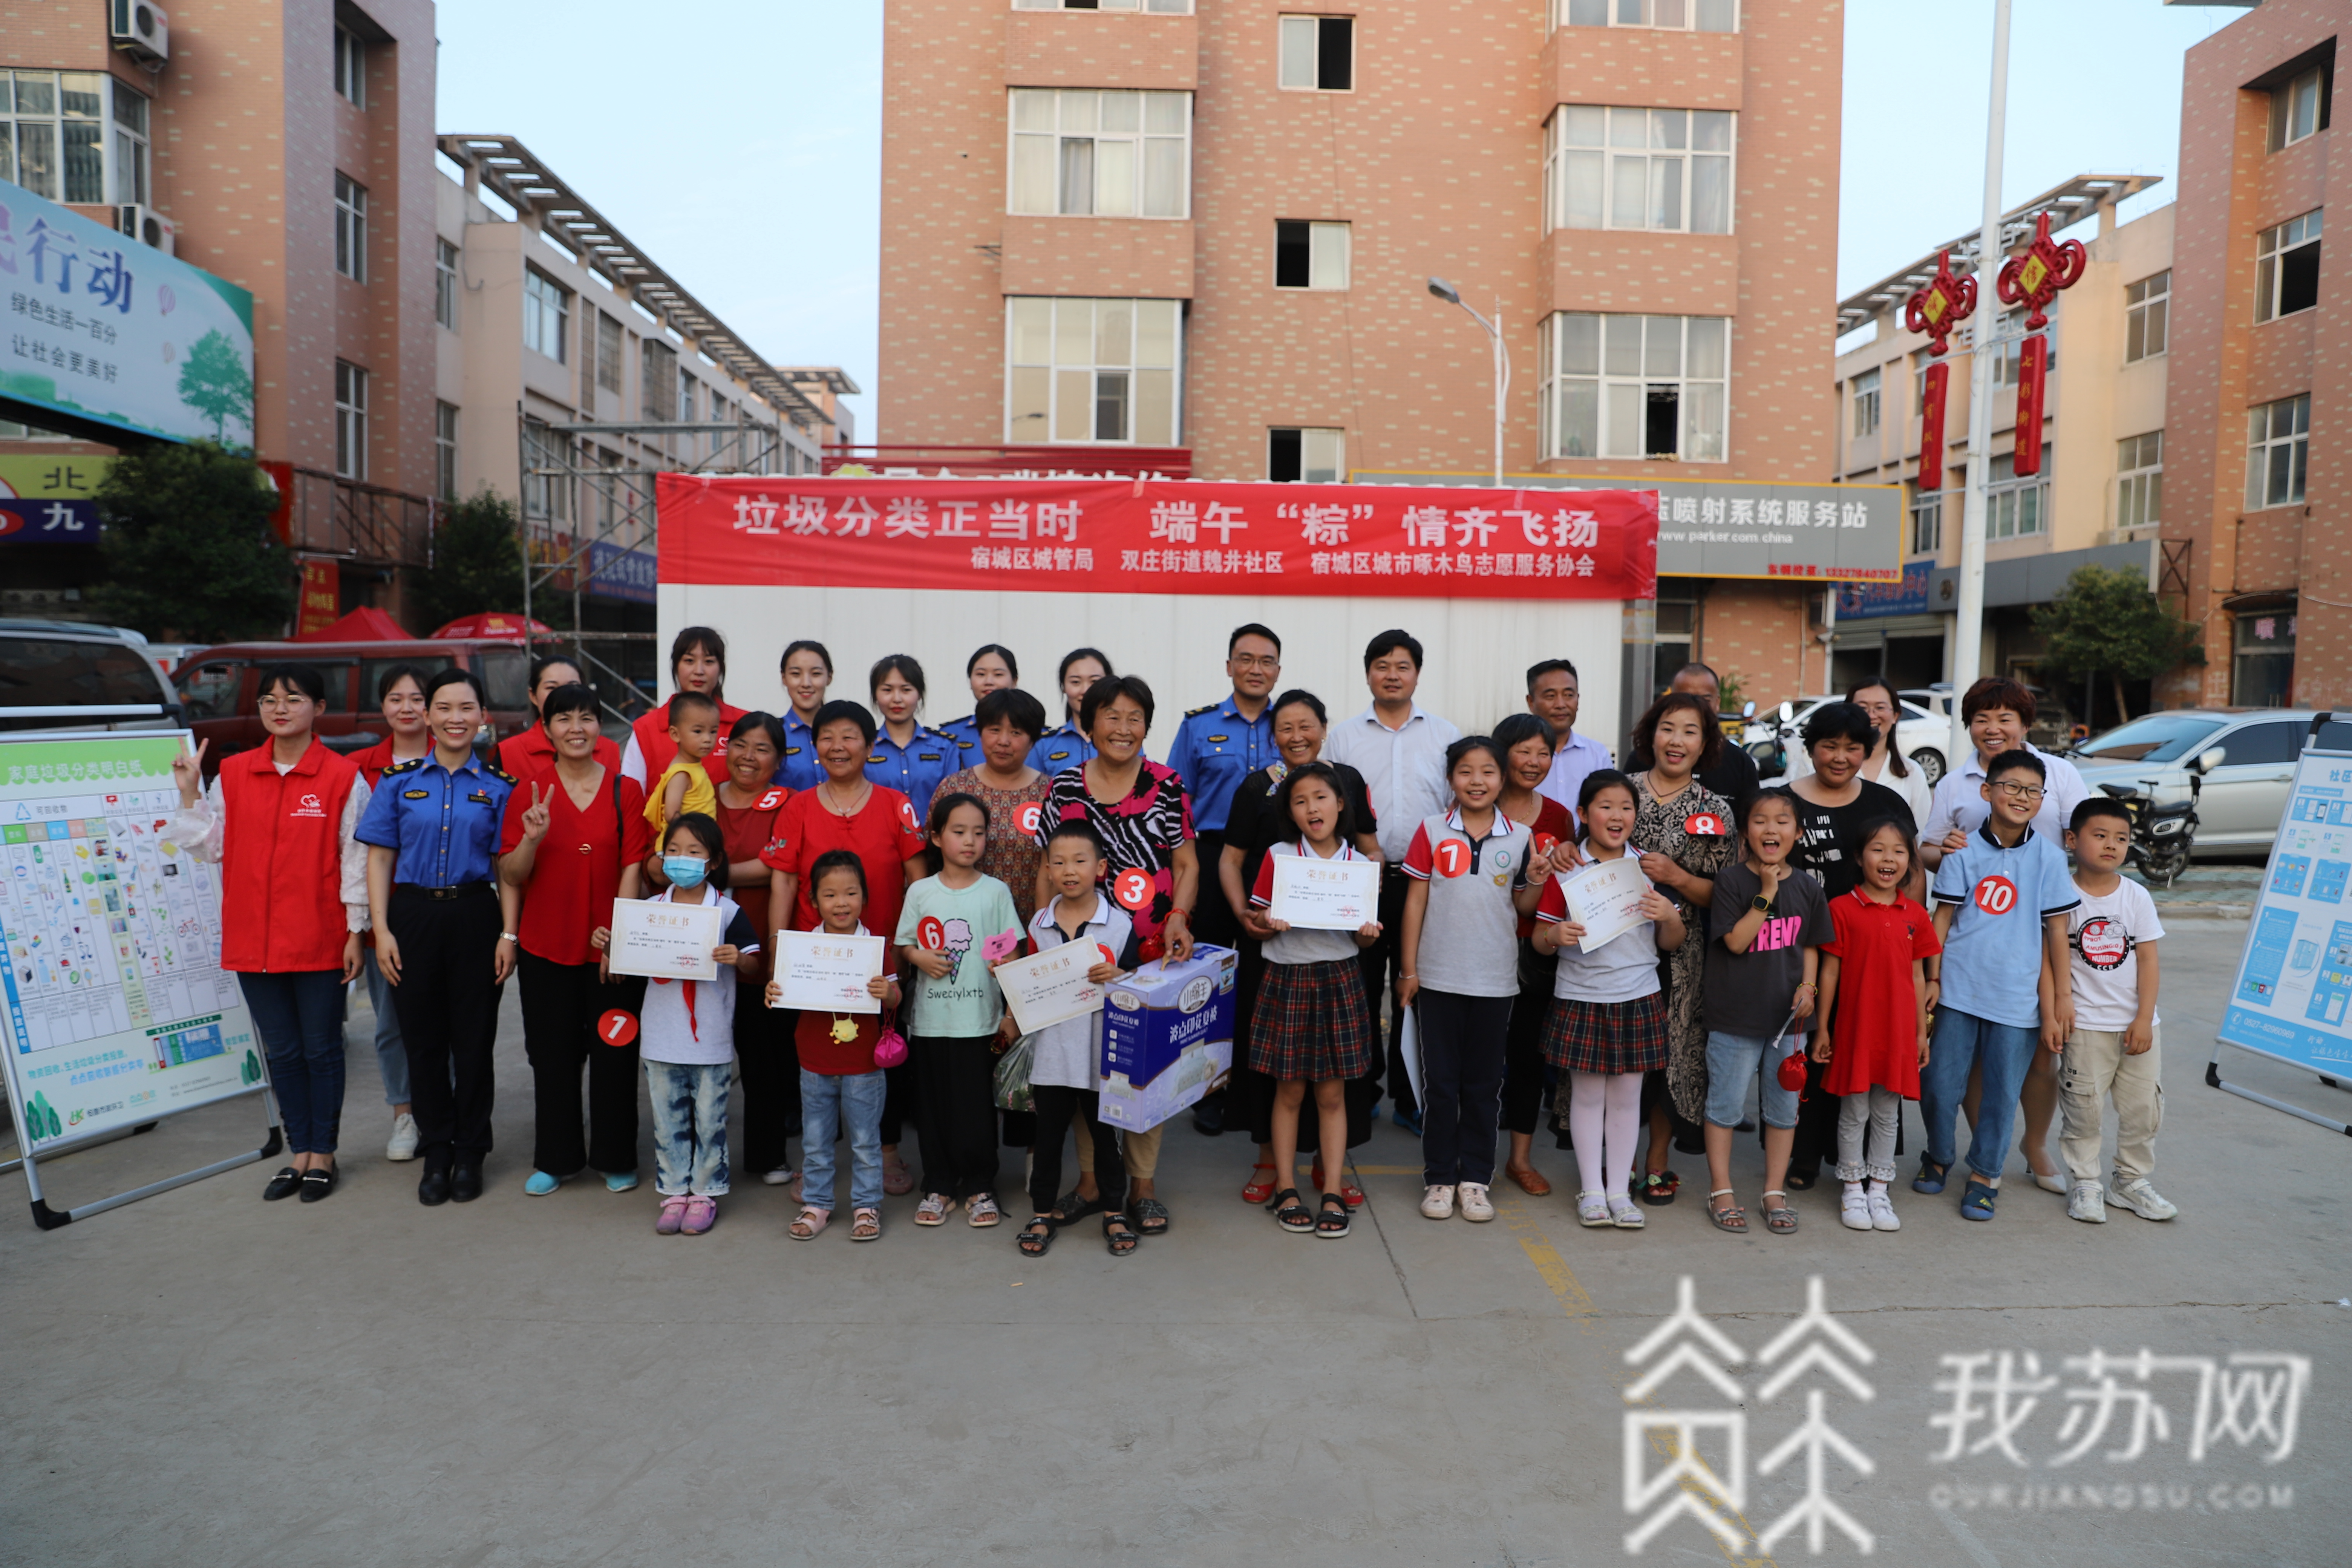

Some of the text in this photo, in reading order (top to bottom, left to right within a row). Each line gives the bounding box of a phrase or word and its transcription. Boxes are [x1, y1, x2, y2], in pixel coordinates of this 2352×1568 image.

[11, 292, 117, 345] 绿色生活一百分
[12, 333, 118, 384] 让社会更美好
[733, 493, 1084, 542] 垃圾分类正当时
[971, 547, 1595, 578] 宿城区城管局 双庄街道魏井社区 宿城区城市啄木鸟志愿服务协会
[8, 759, 144, 782] 家庭垃圾分类明白纸
[759, 791, 782, 808] 5
[902, 802, 920, 828] 2
[1022, 806, 1041, 831] 6
[1695, 815, 1716, 835] 8
[1440, 844, 1459, 873] 7
[1307, 869, 1349, 881] 荣誉证书
[1123, 874, 1147, 903] 3
[1979, 879, 2013, 912] 10
[646, 913, 689, 927] 荣誉证书
[925, 922, 941, 949] 6
[811, 945, 854, 958] 荣誉证书
[2092, 954, 2118, 963] NUMBER
[1183, 981, 1208, 1006] 小绵羊
[607, 1015, 628, 1040] 1
[1169, 1004, 1217, 1044] 波点印花夏被
